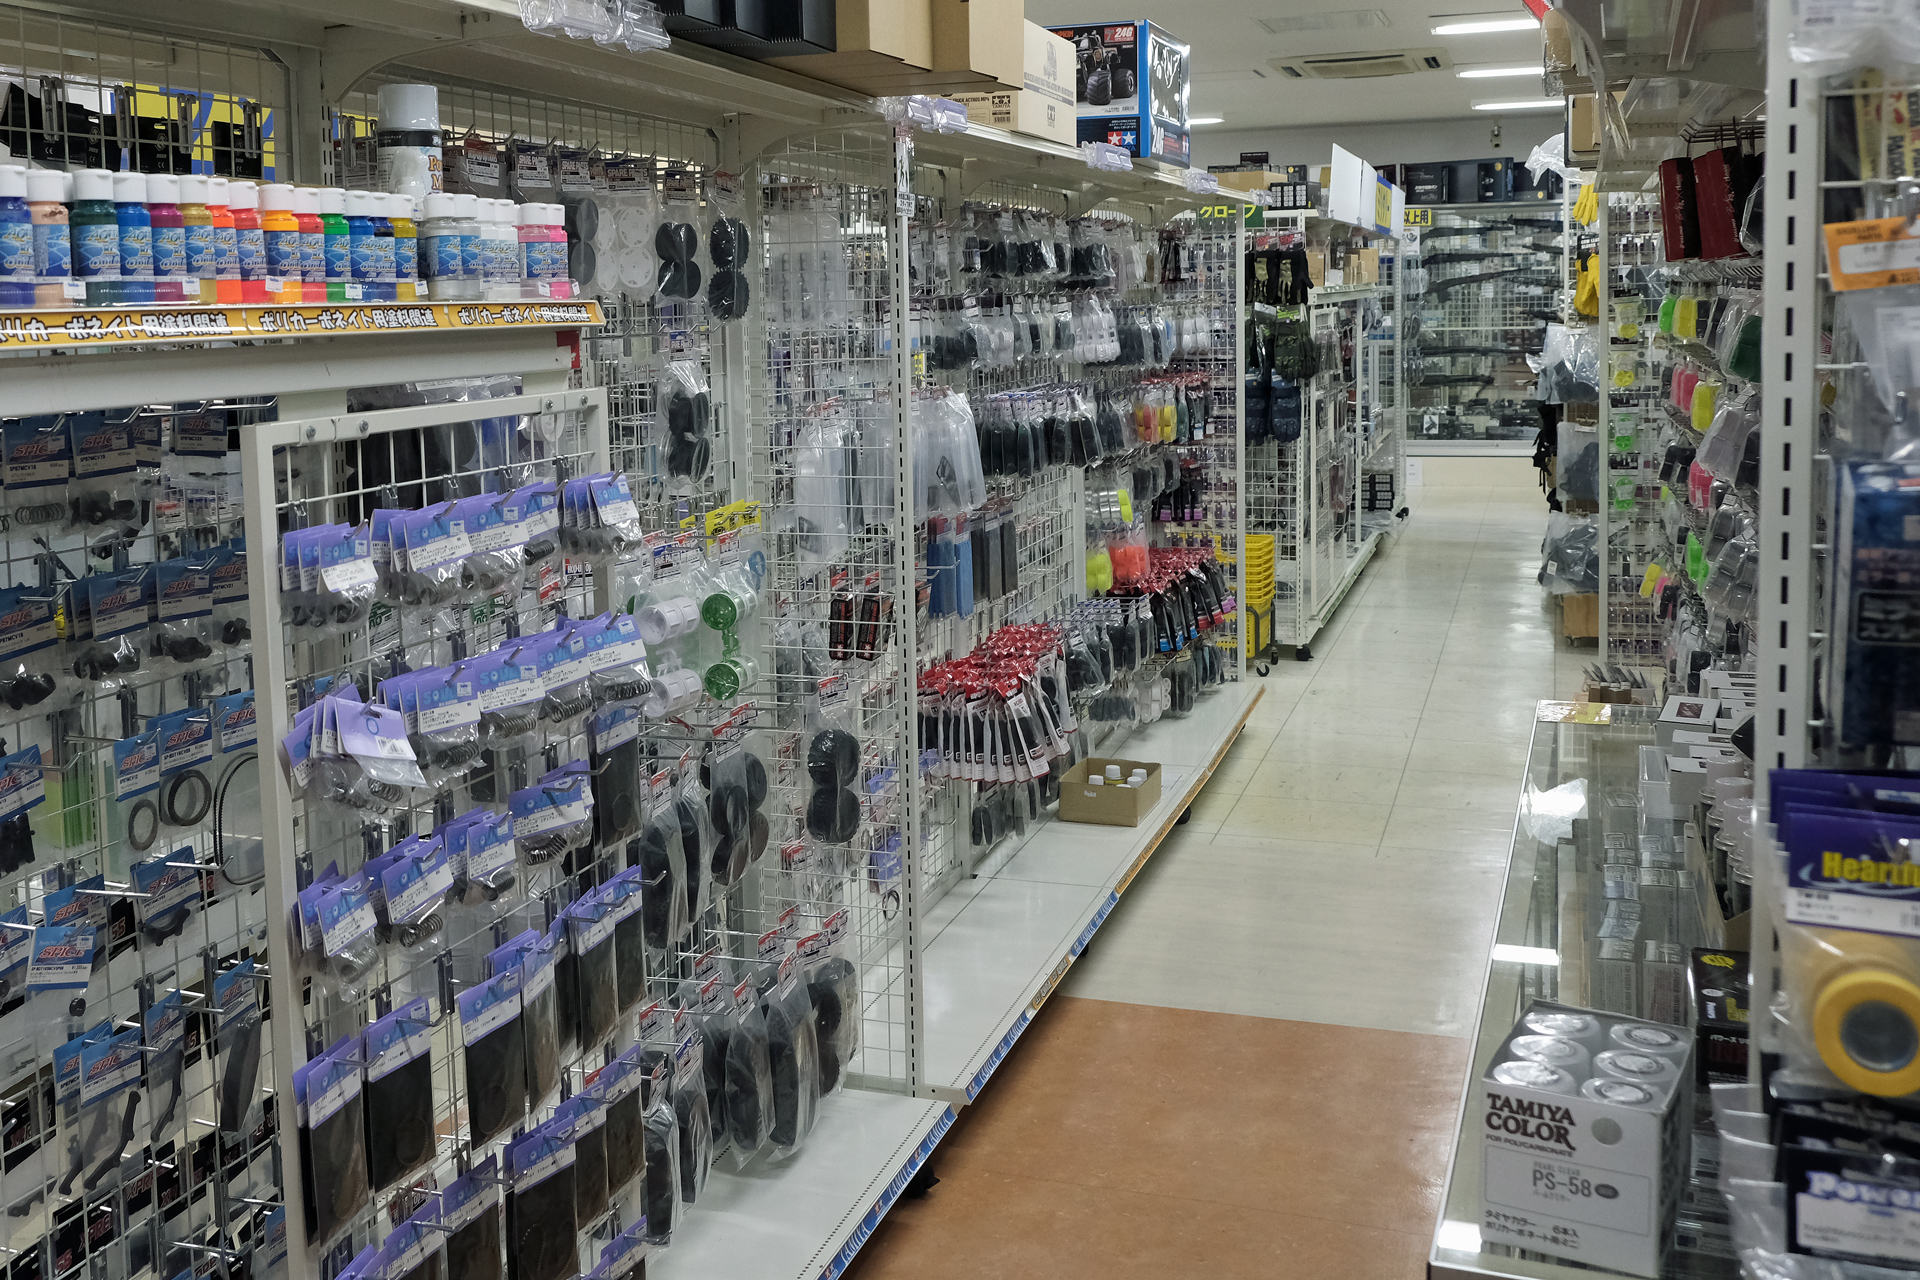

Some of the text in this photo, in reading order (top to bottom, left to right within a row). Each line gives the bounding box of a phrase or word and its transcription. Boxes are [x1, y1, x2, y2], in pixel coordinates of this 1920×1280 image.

[259, 308, 438, 332] ポリカーボネイト用塗料関連
[1487, 1093, 1576, 1126] TAMIYA
[927, 1113, 951, 1149] TAMIYA
[1485, 1112, 1576, 1151] COLOR
[1486, 1134, 1573, 1158] FOR POLYCARBONATE
[887, 1162, 916, 1199] TAMIYA
[1532, 1169, 1592, 1198] PS-58
[1485, 1209, 1579, 1238] タミヤカラー 6本入
[840, 1221, 870, 1265] TAMIYA
